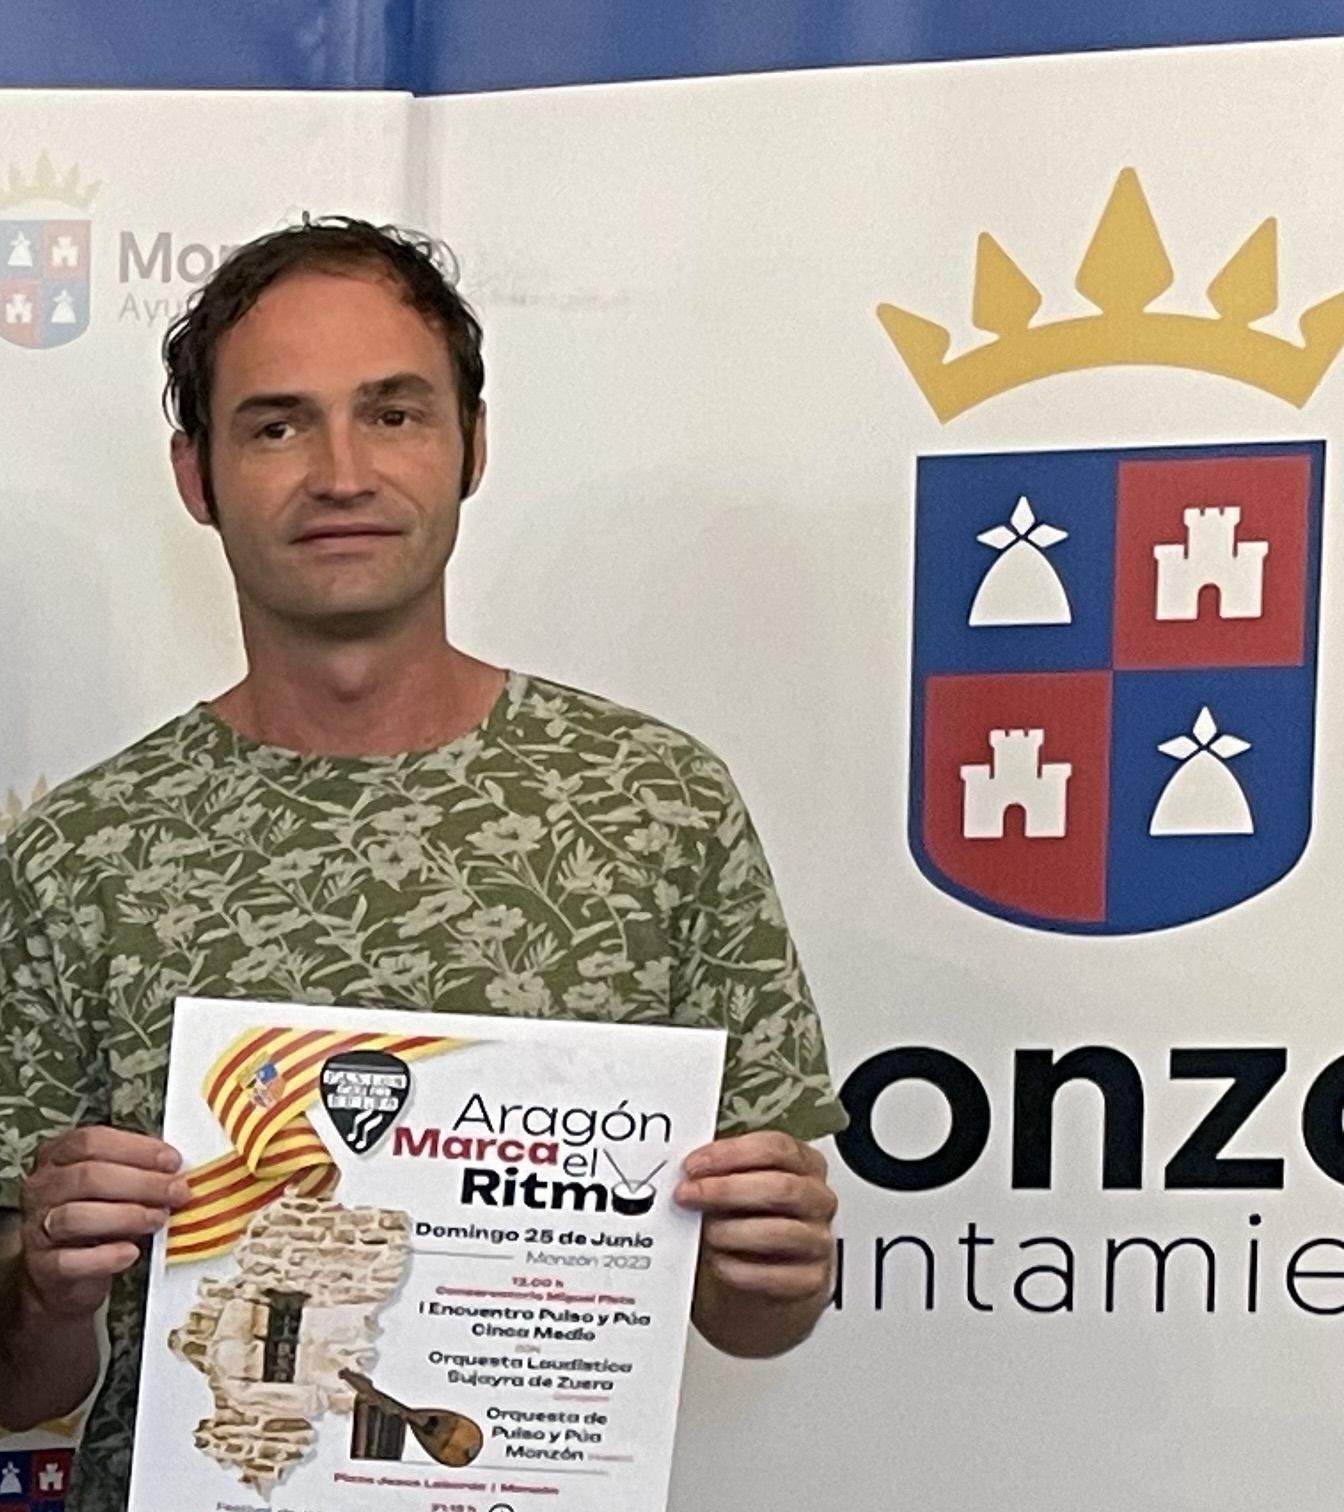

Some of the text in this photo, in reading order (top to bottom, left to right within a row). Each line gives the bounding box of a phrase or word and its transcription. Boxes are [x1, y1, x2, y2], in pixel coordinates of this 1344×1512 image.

[452, 1093, 672, 1147] Aragón
[392, 1126, 597, 1177] Marca el
[415, 1222, 653, 1248] Domingo 25 de Junio
[526, 1251, 652, 1270] Monzón 2023
[429, 1302, 534, 1320] Encuentro
[597, 1313, 608, 1326] y
[429, 1351, 523, 1369] Orquesta
[529, 1374, 552, 1388] de
[487, 1407, 607, 1425] Orquesta de
[550, 1430, 560, 1443] y
[506, 1445, 584, 1461] Monzón
